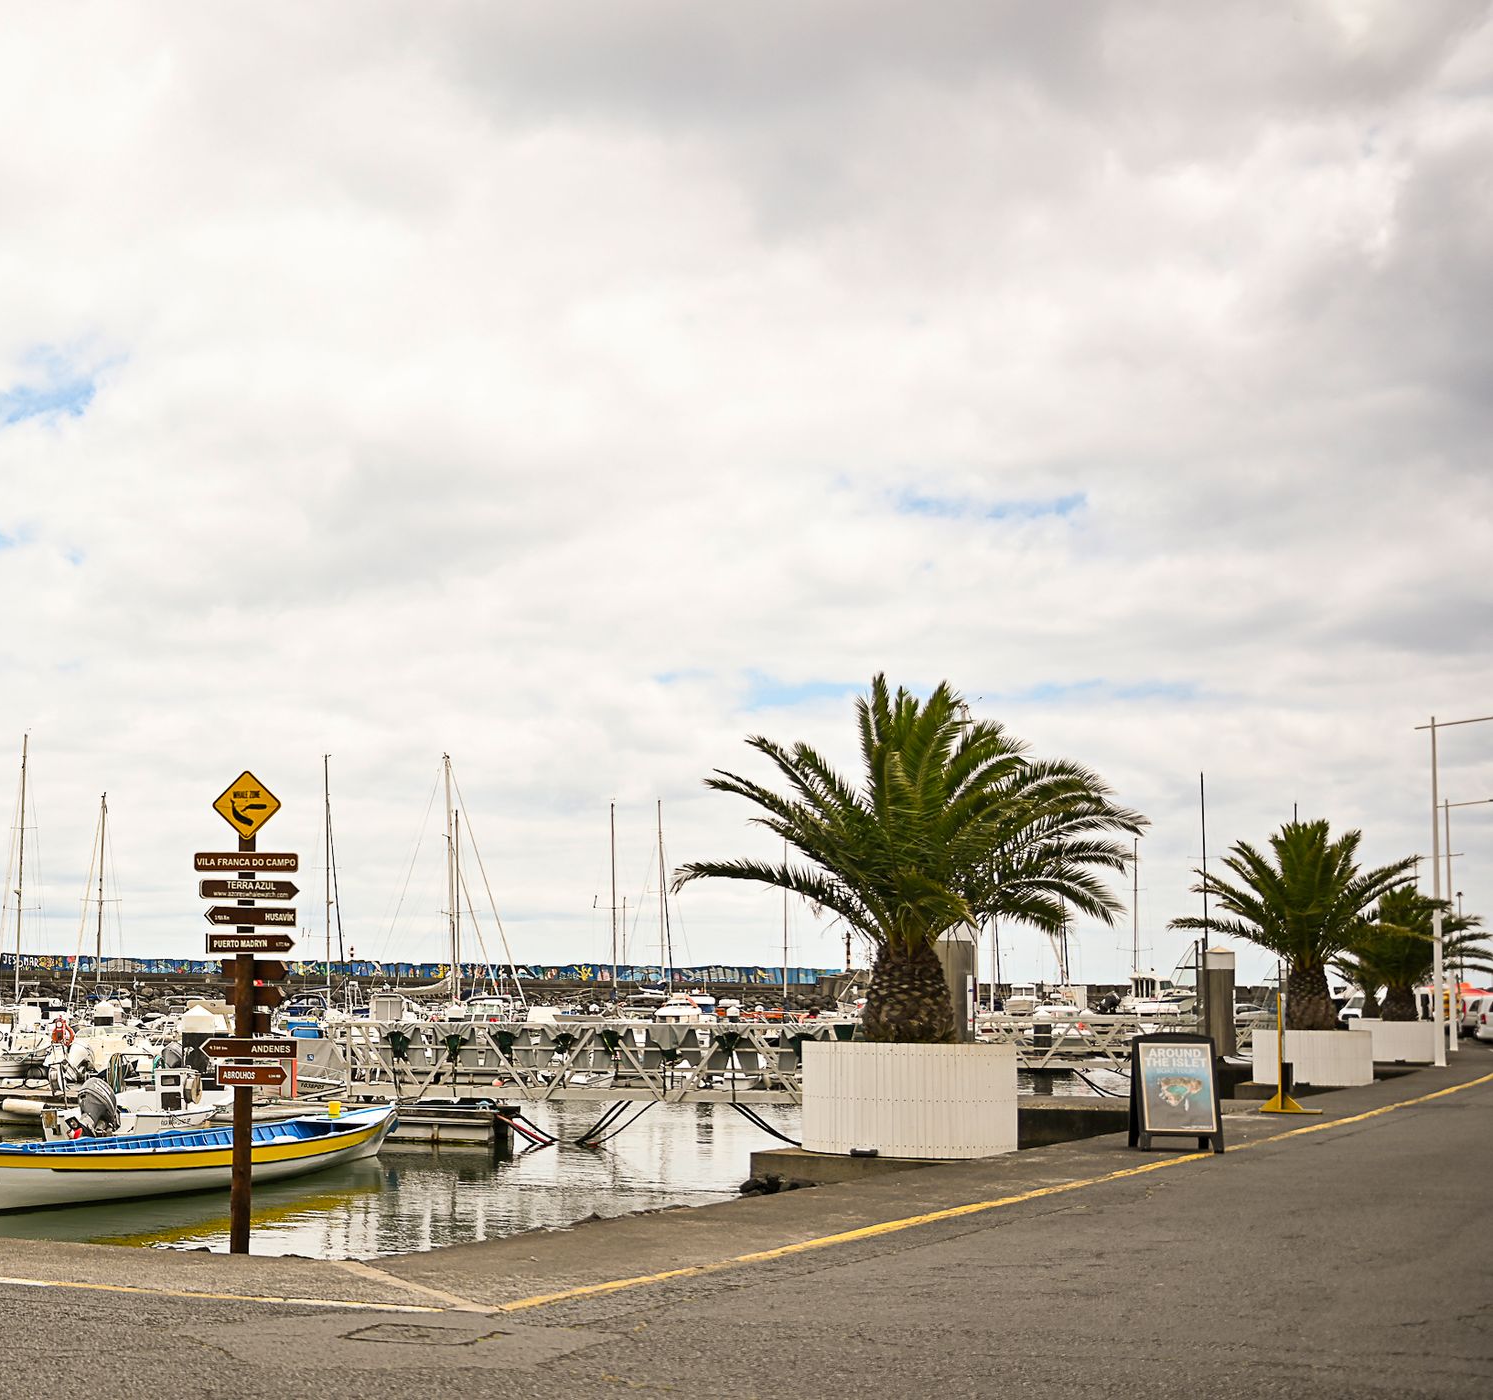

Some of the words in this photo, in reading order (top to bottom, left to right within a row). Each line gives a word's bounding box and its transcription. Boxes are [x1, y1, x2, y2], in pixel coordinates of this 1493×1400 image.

[196, 858, 215, 866] VILA
[217, 858, 250, 866] FRANCA
[252, 858, 264, 866] DO
[266, 859, 296, 867] CAMPO
[226, 881, 255, 890] TERRA
[255, 881, 276, 890] AZUL
[213, 940, 239, 948] PUERTO
[240, 940, 267, 948] MADRYN
[251, 1045, 291, 1053] ANDENES
[1149, 1048, 1201, 1058] AROUND
[1145, 1057, 1169, 1067] THE
[1172, 1058, 1207, 1068] ISLET
[223, 1071, 256, 1080] ABROLHOS
